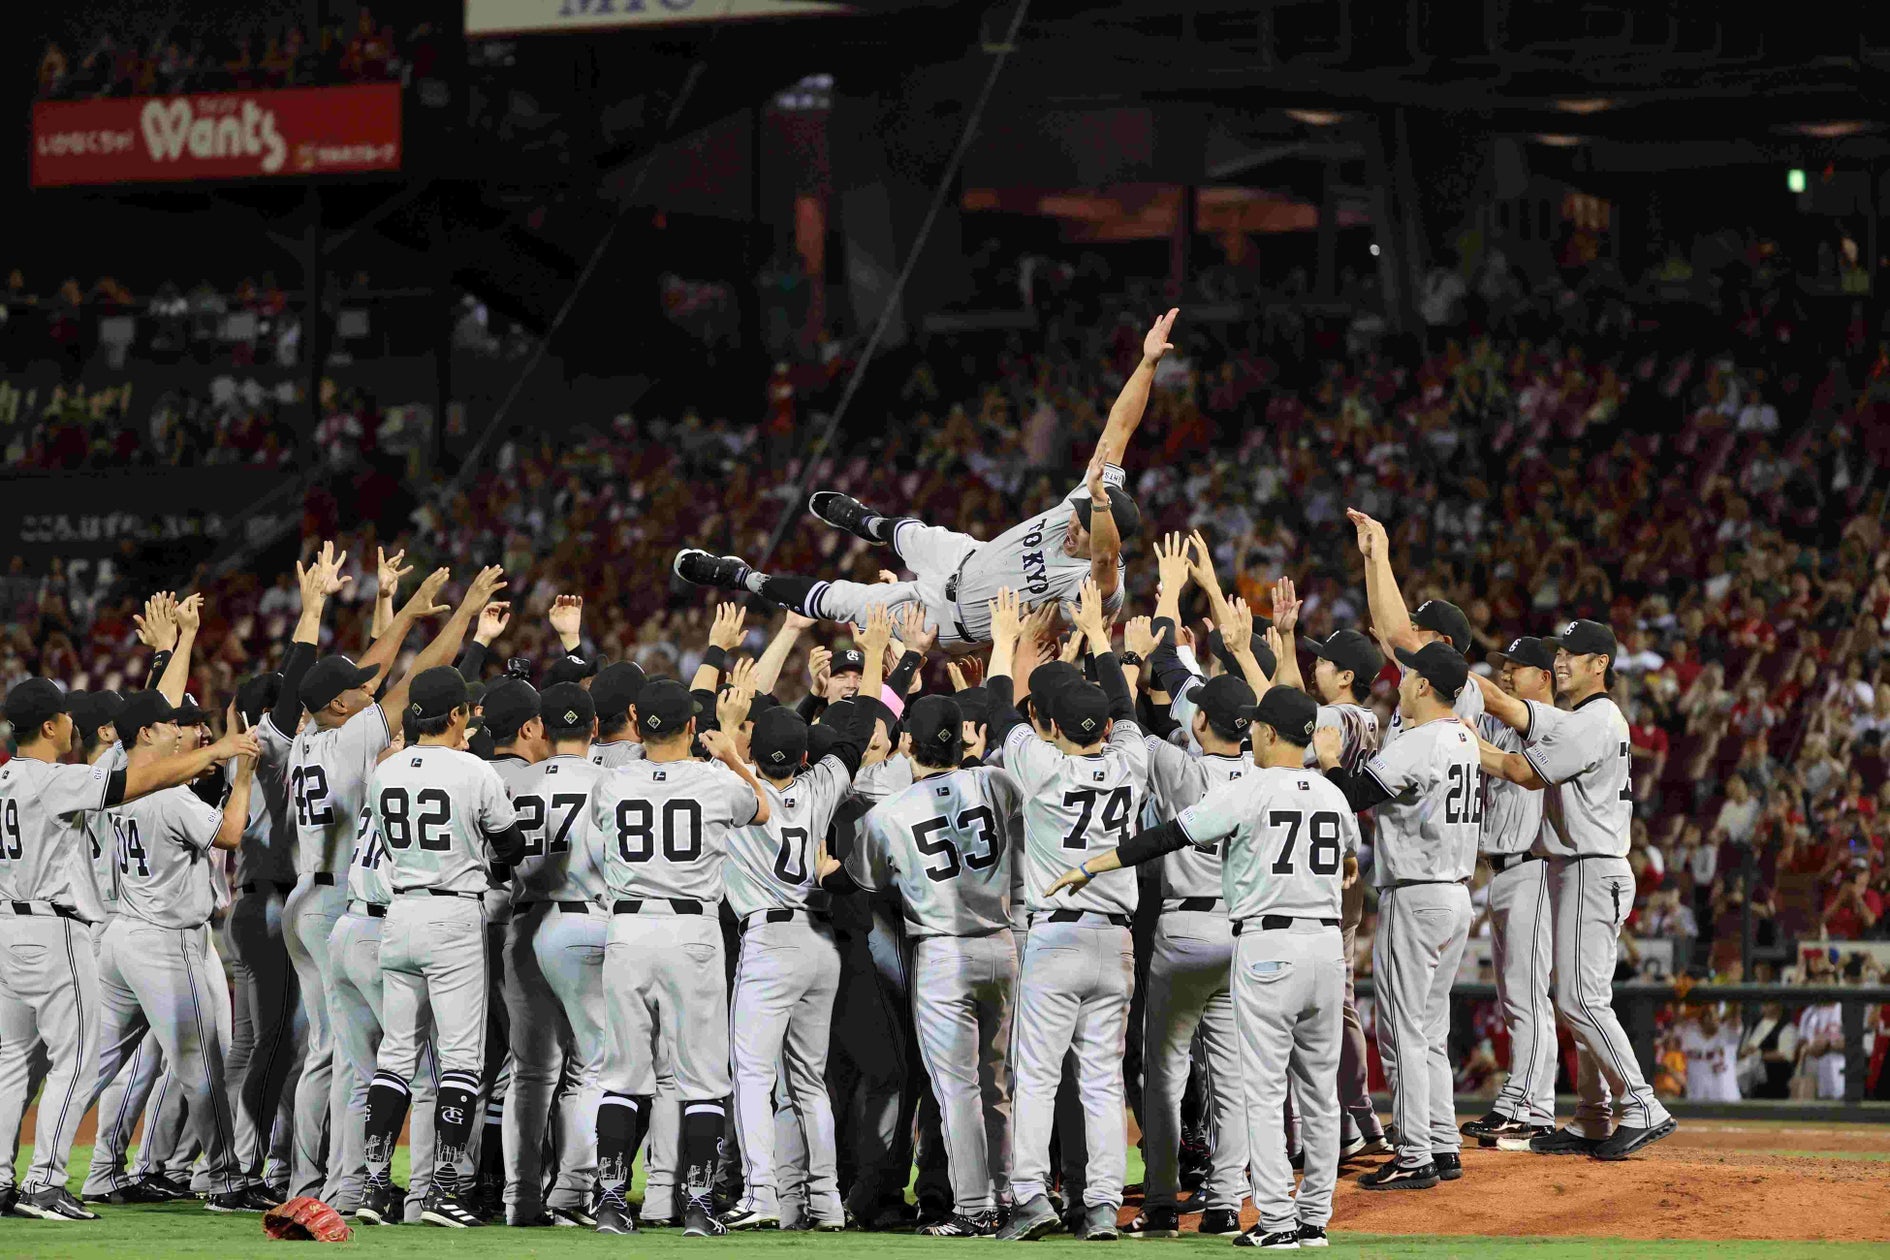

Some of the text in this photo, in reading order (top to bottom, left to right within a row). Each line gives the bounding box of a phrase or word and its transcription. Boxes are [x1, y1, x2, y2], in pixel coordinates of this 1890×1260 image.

[141, 97, 287, 173] Wants
[1022, 517, 1050, 595] TOKYO
[379, 786, 452, 852] 82
[511, 792, 588, 856] 27
[615, 797, 704, 864] 80
[911, 804, 1000, 884] 53
[1062, 784, 1133, 852] 74
[1268, 810, 1341, 876] 78
[772, 826, 809, 886] 0
